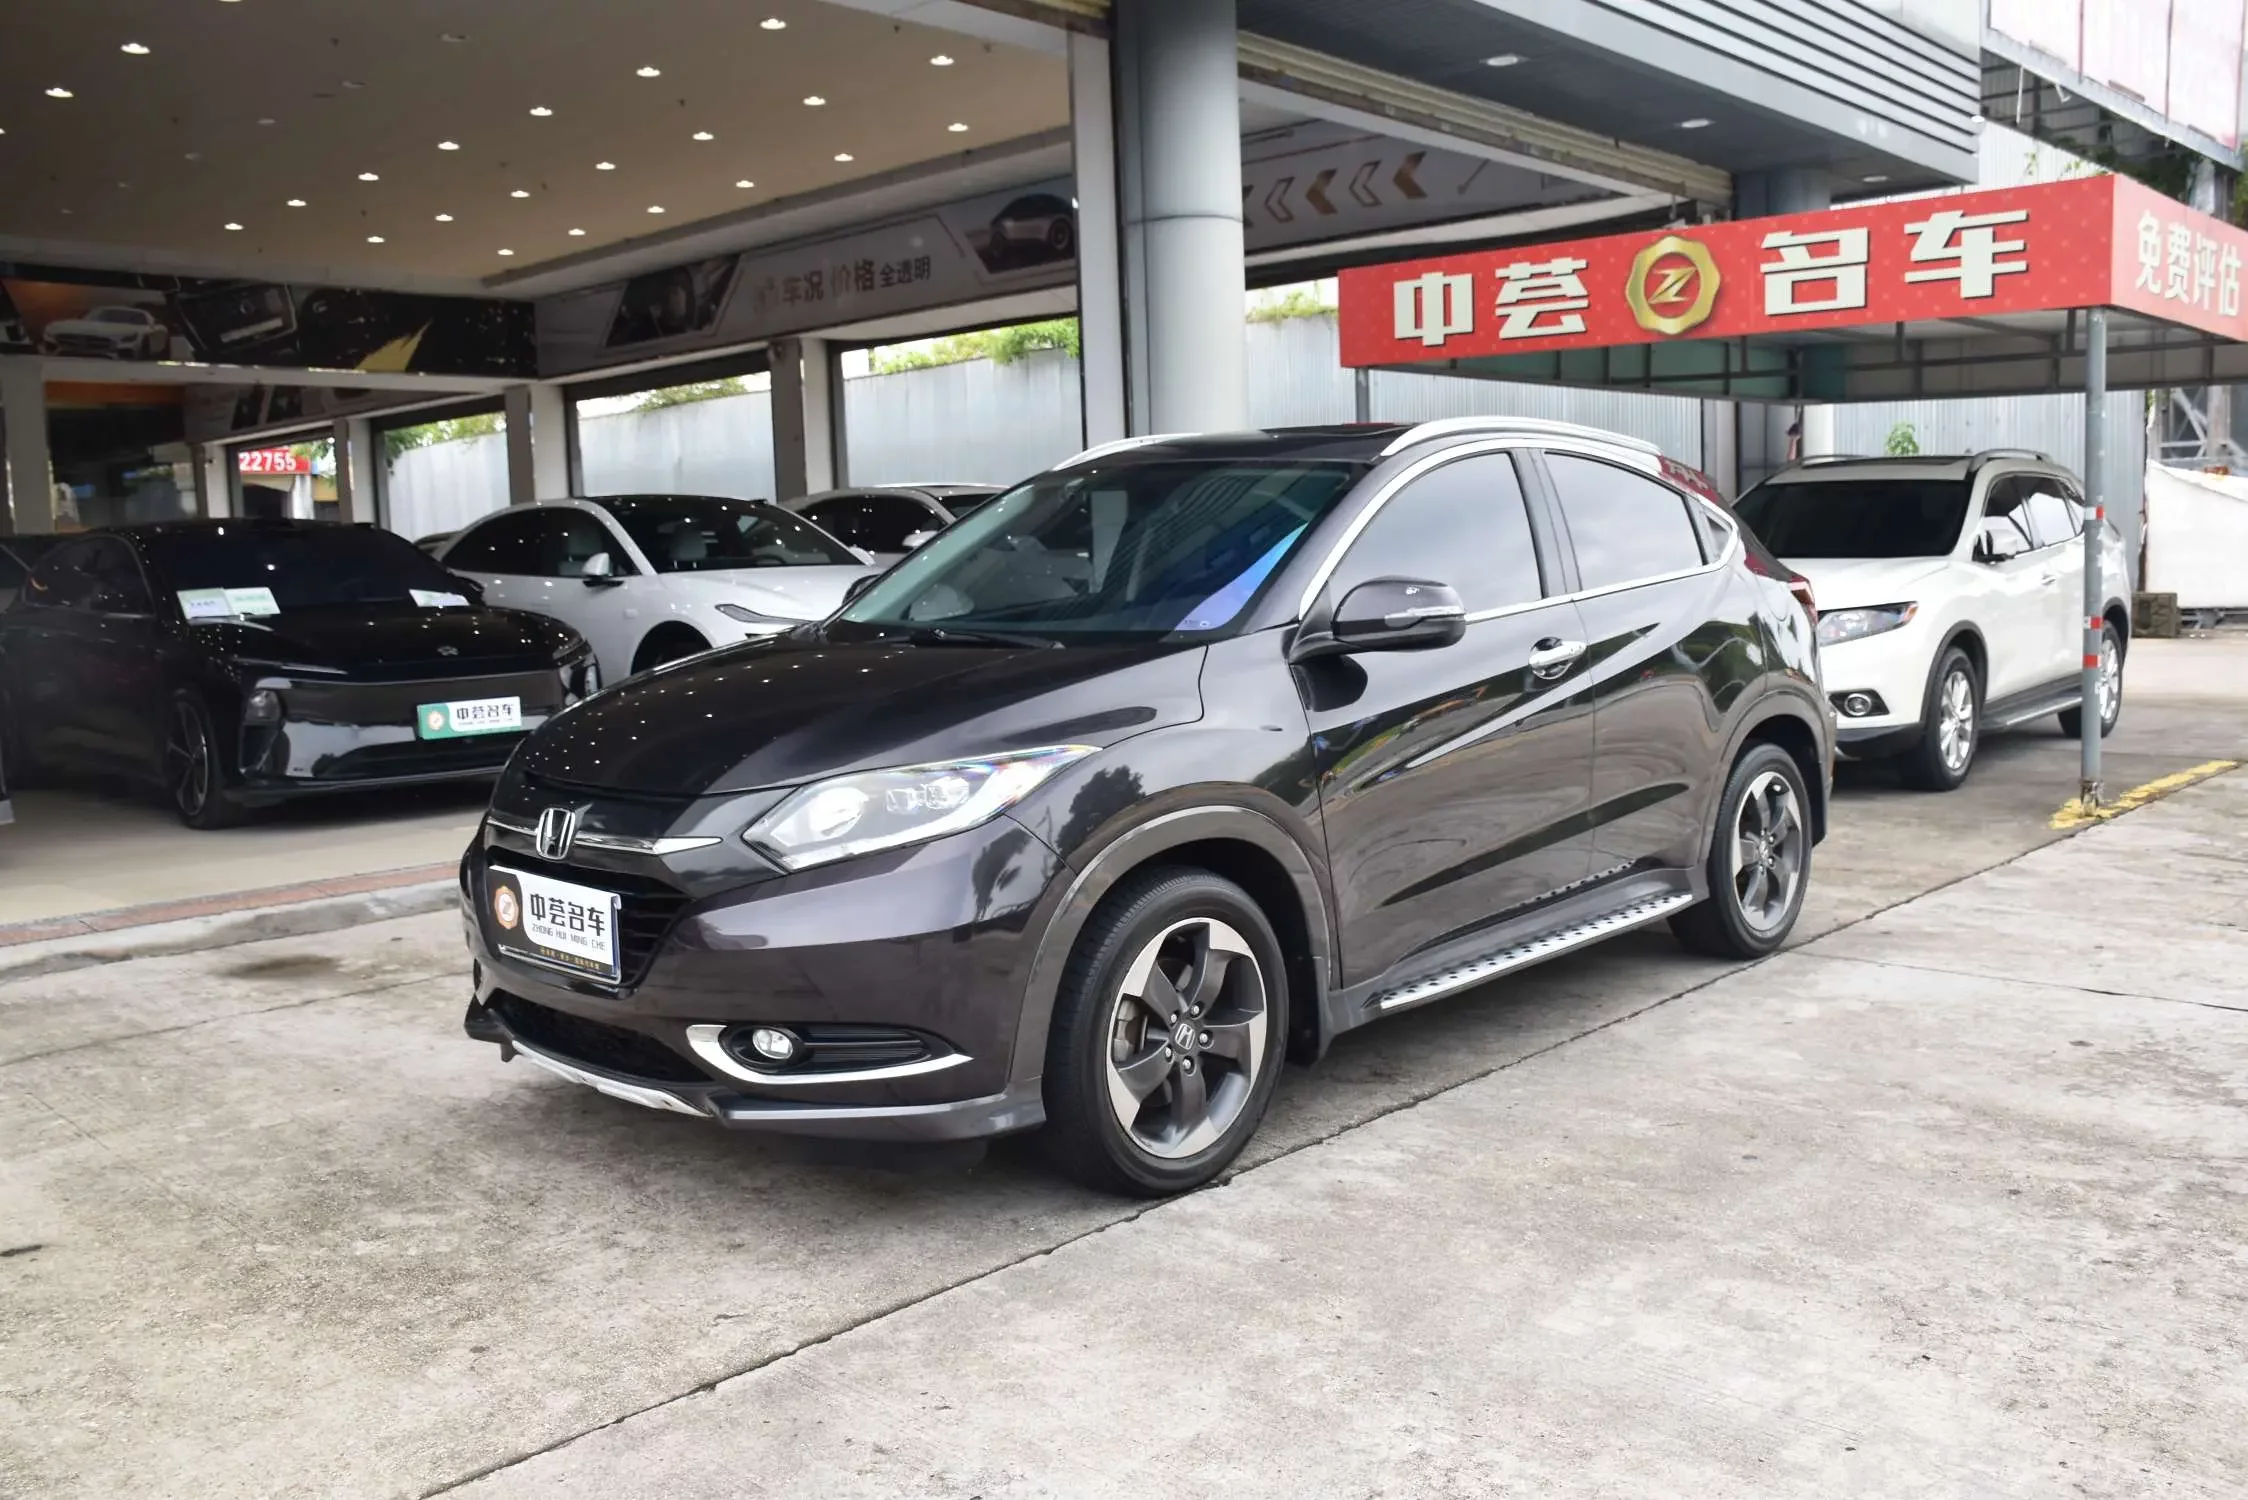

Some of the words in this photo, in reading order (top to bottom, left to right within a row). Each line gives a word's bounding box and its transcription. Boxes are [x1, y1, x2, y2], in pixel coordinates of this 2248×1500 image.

[1393, 257, 1590, 348] 中荟
[1759, 210, 2030, 316] 名车
[2135, 209, 2242, 316] 免费评估
[530, 893, 606, 937] 中荟名车
